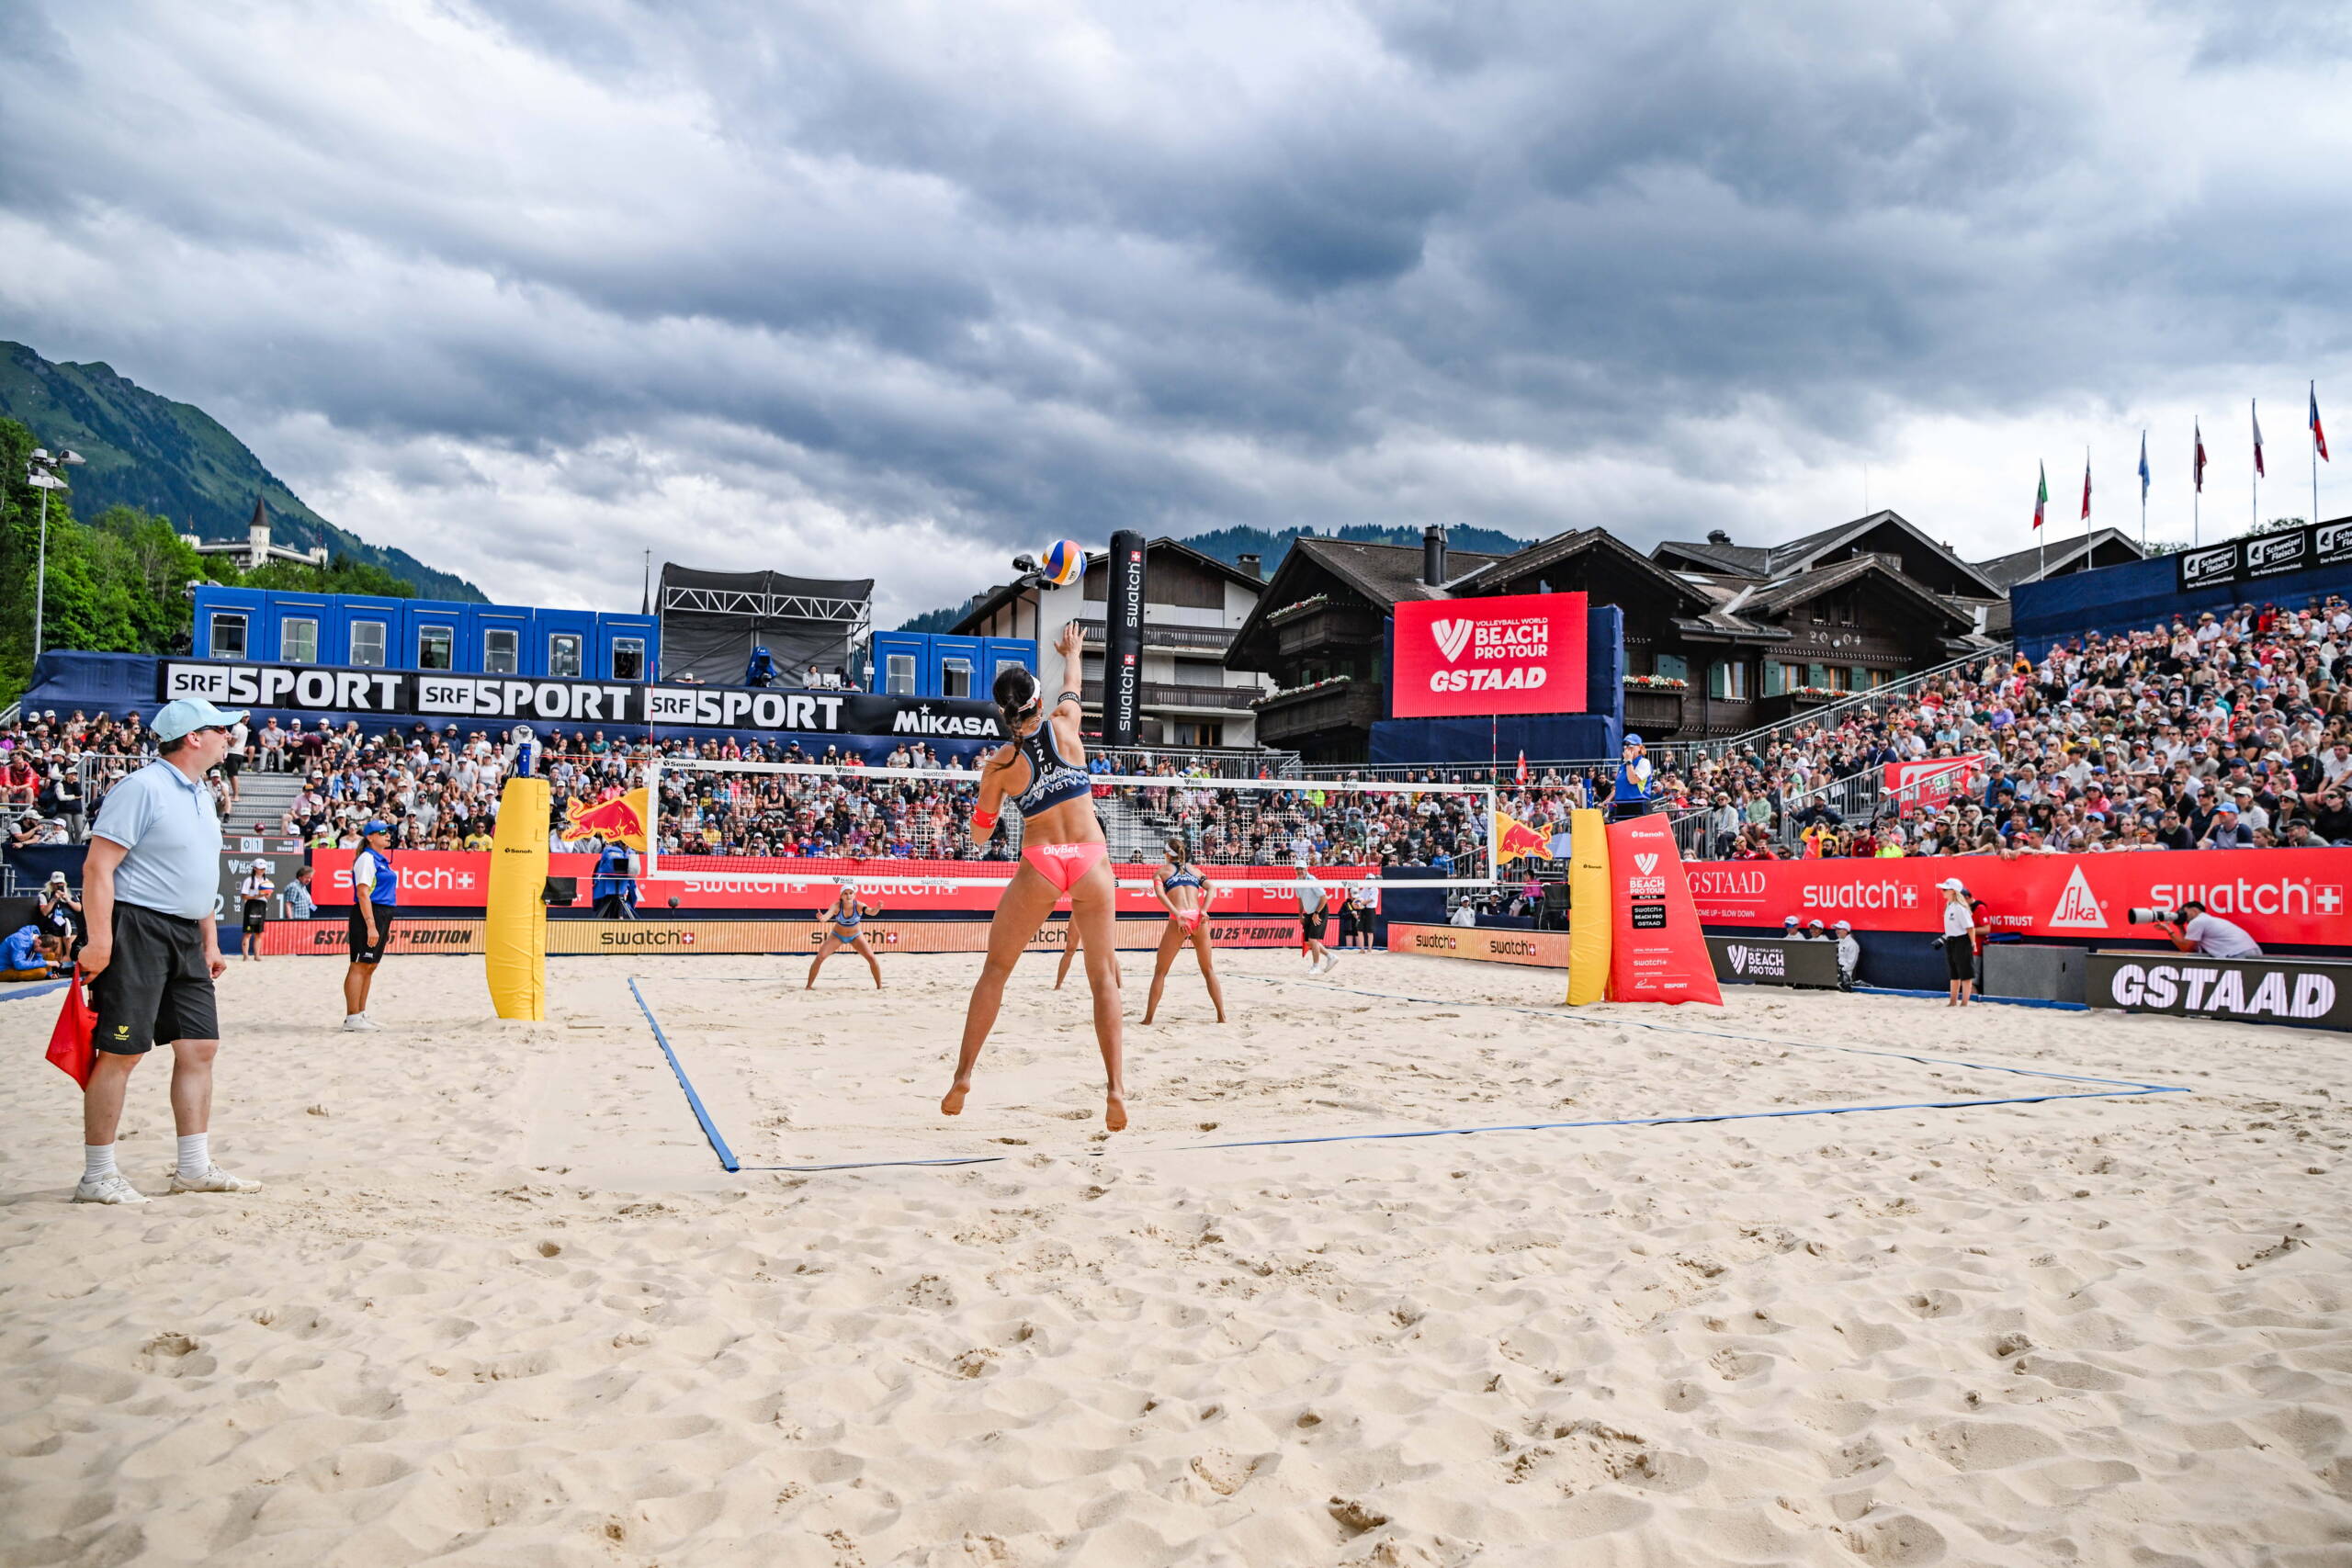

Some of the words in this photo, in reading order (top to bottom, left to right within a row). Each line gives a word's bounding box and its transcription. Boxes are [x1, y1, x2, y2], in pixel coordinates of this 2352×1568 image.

[2266, 537, 2301, 556] Schweizer
[2271, 547, 2296, 561] Fleisch
[2200, 551, 2233, 569] Schweizer
[2206, 560, 2229, 574] Fleisch
[1126, 562, 1141, 628] swatch
[1476, 619, 1521, 627] VOLLEYBALL
[1521, 616, 1548, 625] WORLD
[1475, 625, 1548, 647] BEACH
[1475, 646, 1507, 660] PRO
[1508, 644, 1548, 658] TOUR
[1430, 667, 1547, 693] GSTAAD
[175, 673, 222, 694] SRF
[229, 667, 402, 710] SPORT
[425, 686, 469, 704] SRF
[474, 680, 632, 721] SPORT
[1120, 665, 1135, 731] swatch
[651, 695, 692, 715] SRF
[696, 691, 843, 730] SPORT
[1036, 749, 1046, 762] 2
[1040, 761, 1053, 775] LAT
[1046, 775, 1078, 794] VBTV
[1044, 844, 1080, 856] OlyBet
[334, 867, 453, 889] stch
[1630, 880, 1666, 888] BEACH
[1688, 871, 1766, 894] GSTAAD
[1804, 879, 1899, 908] swatch
[2057, 886, 2098, 921] Sika
[2004, 916, 2033, 927] TRUST
[411, 930, 472, 944] EDITION
[601, 930, 680, 945] swatch
[1250, 927, 1295, 940] EDITION
[1416, 933, 1451, 949] swatch
[1490, 941, 1529, 955] swatch
[1748, 953, 1785, 966] BEACH
[1748, 965, 1764, 976] PRO
[1764, 965, 1785, 976] TOUR
[2111, 964, 2336, 1019] GSTAAD
